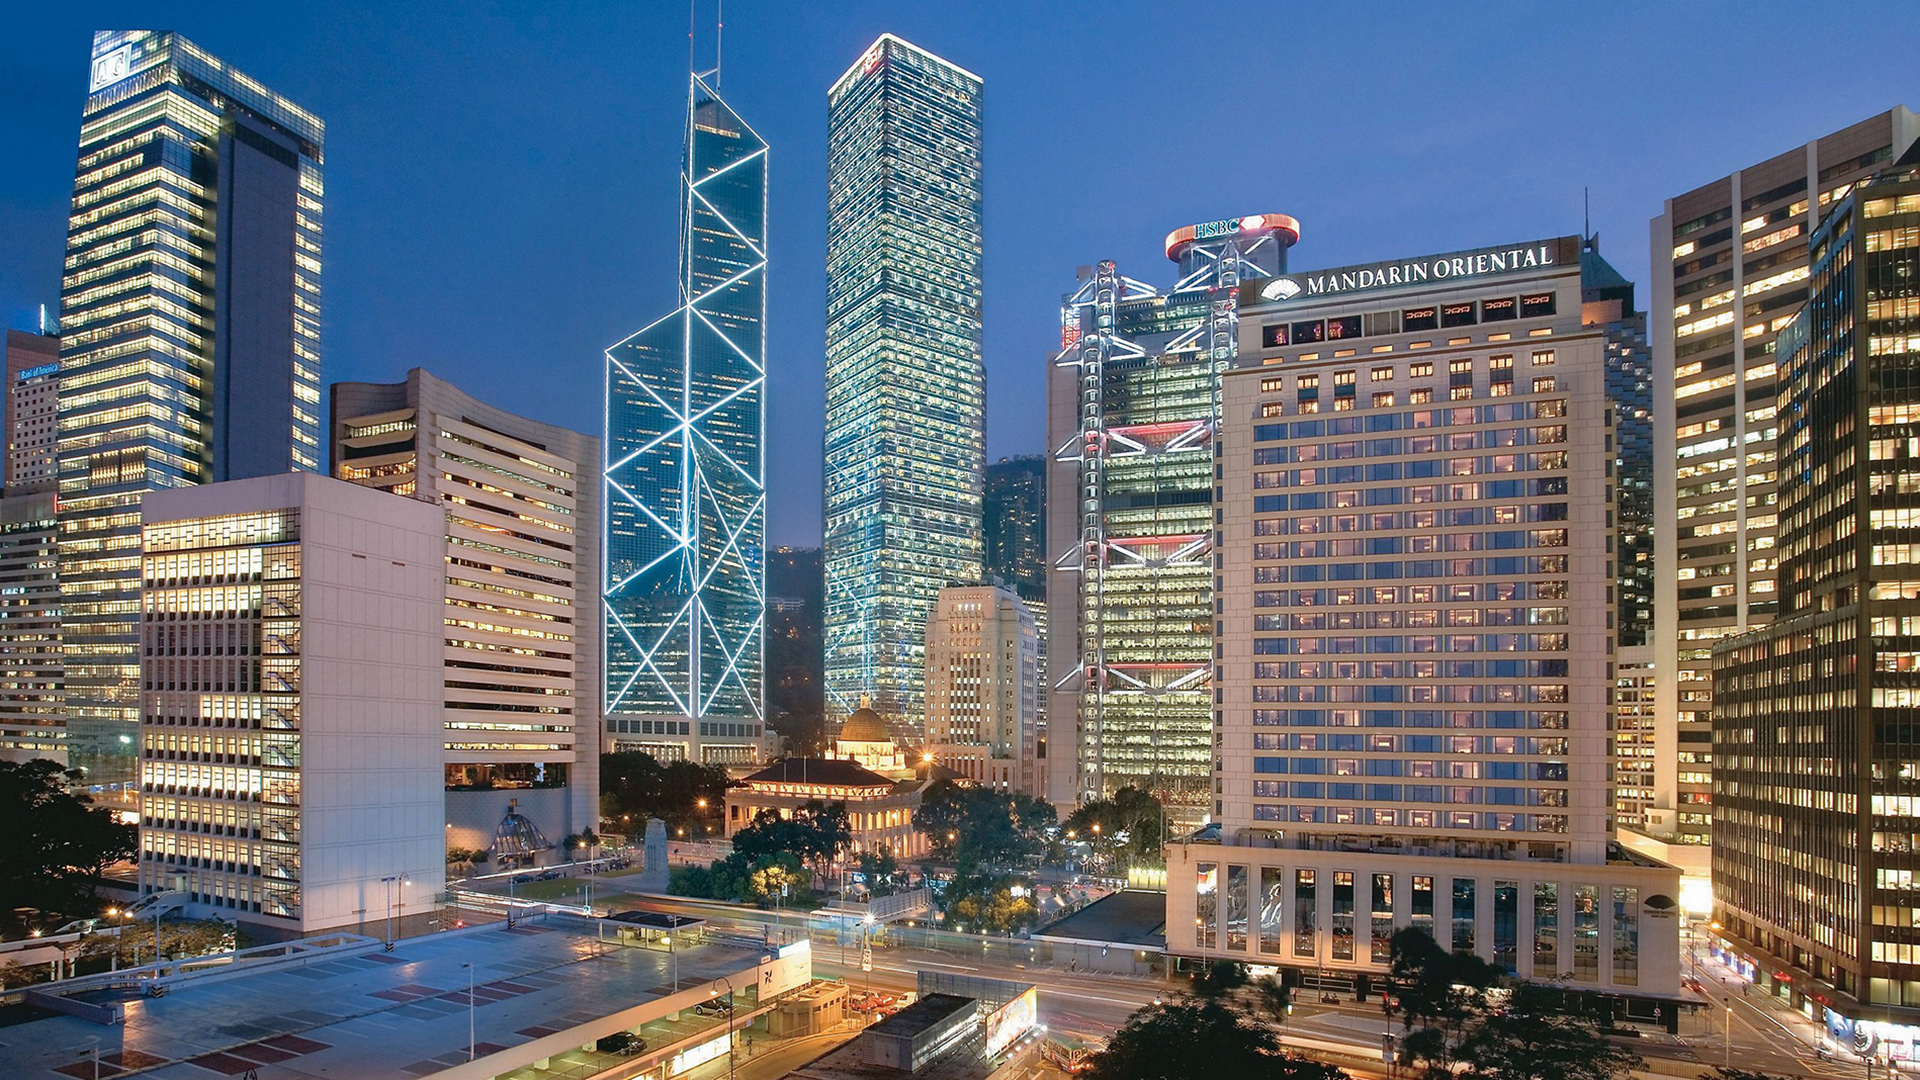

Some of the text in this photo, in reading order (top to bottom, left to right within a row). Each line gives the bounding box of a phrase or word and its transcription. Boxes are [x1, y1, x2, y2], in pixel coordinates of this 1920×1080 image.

[1193, 218, 1240, 240] HSBC
[1307, 246, 1553, 295] MANDARIN ORIENTAL
